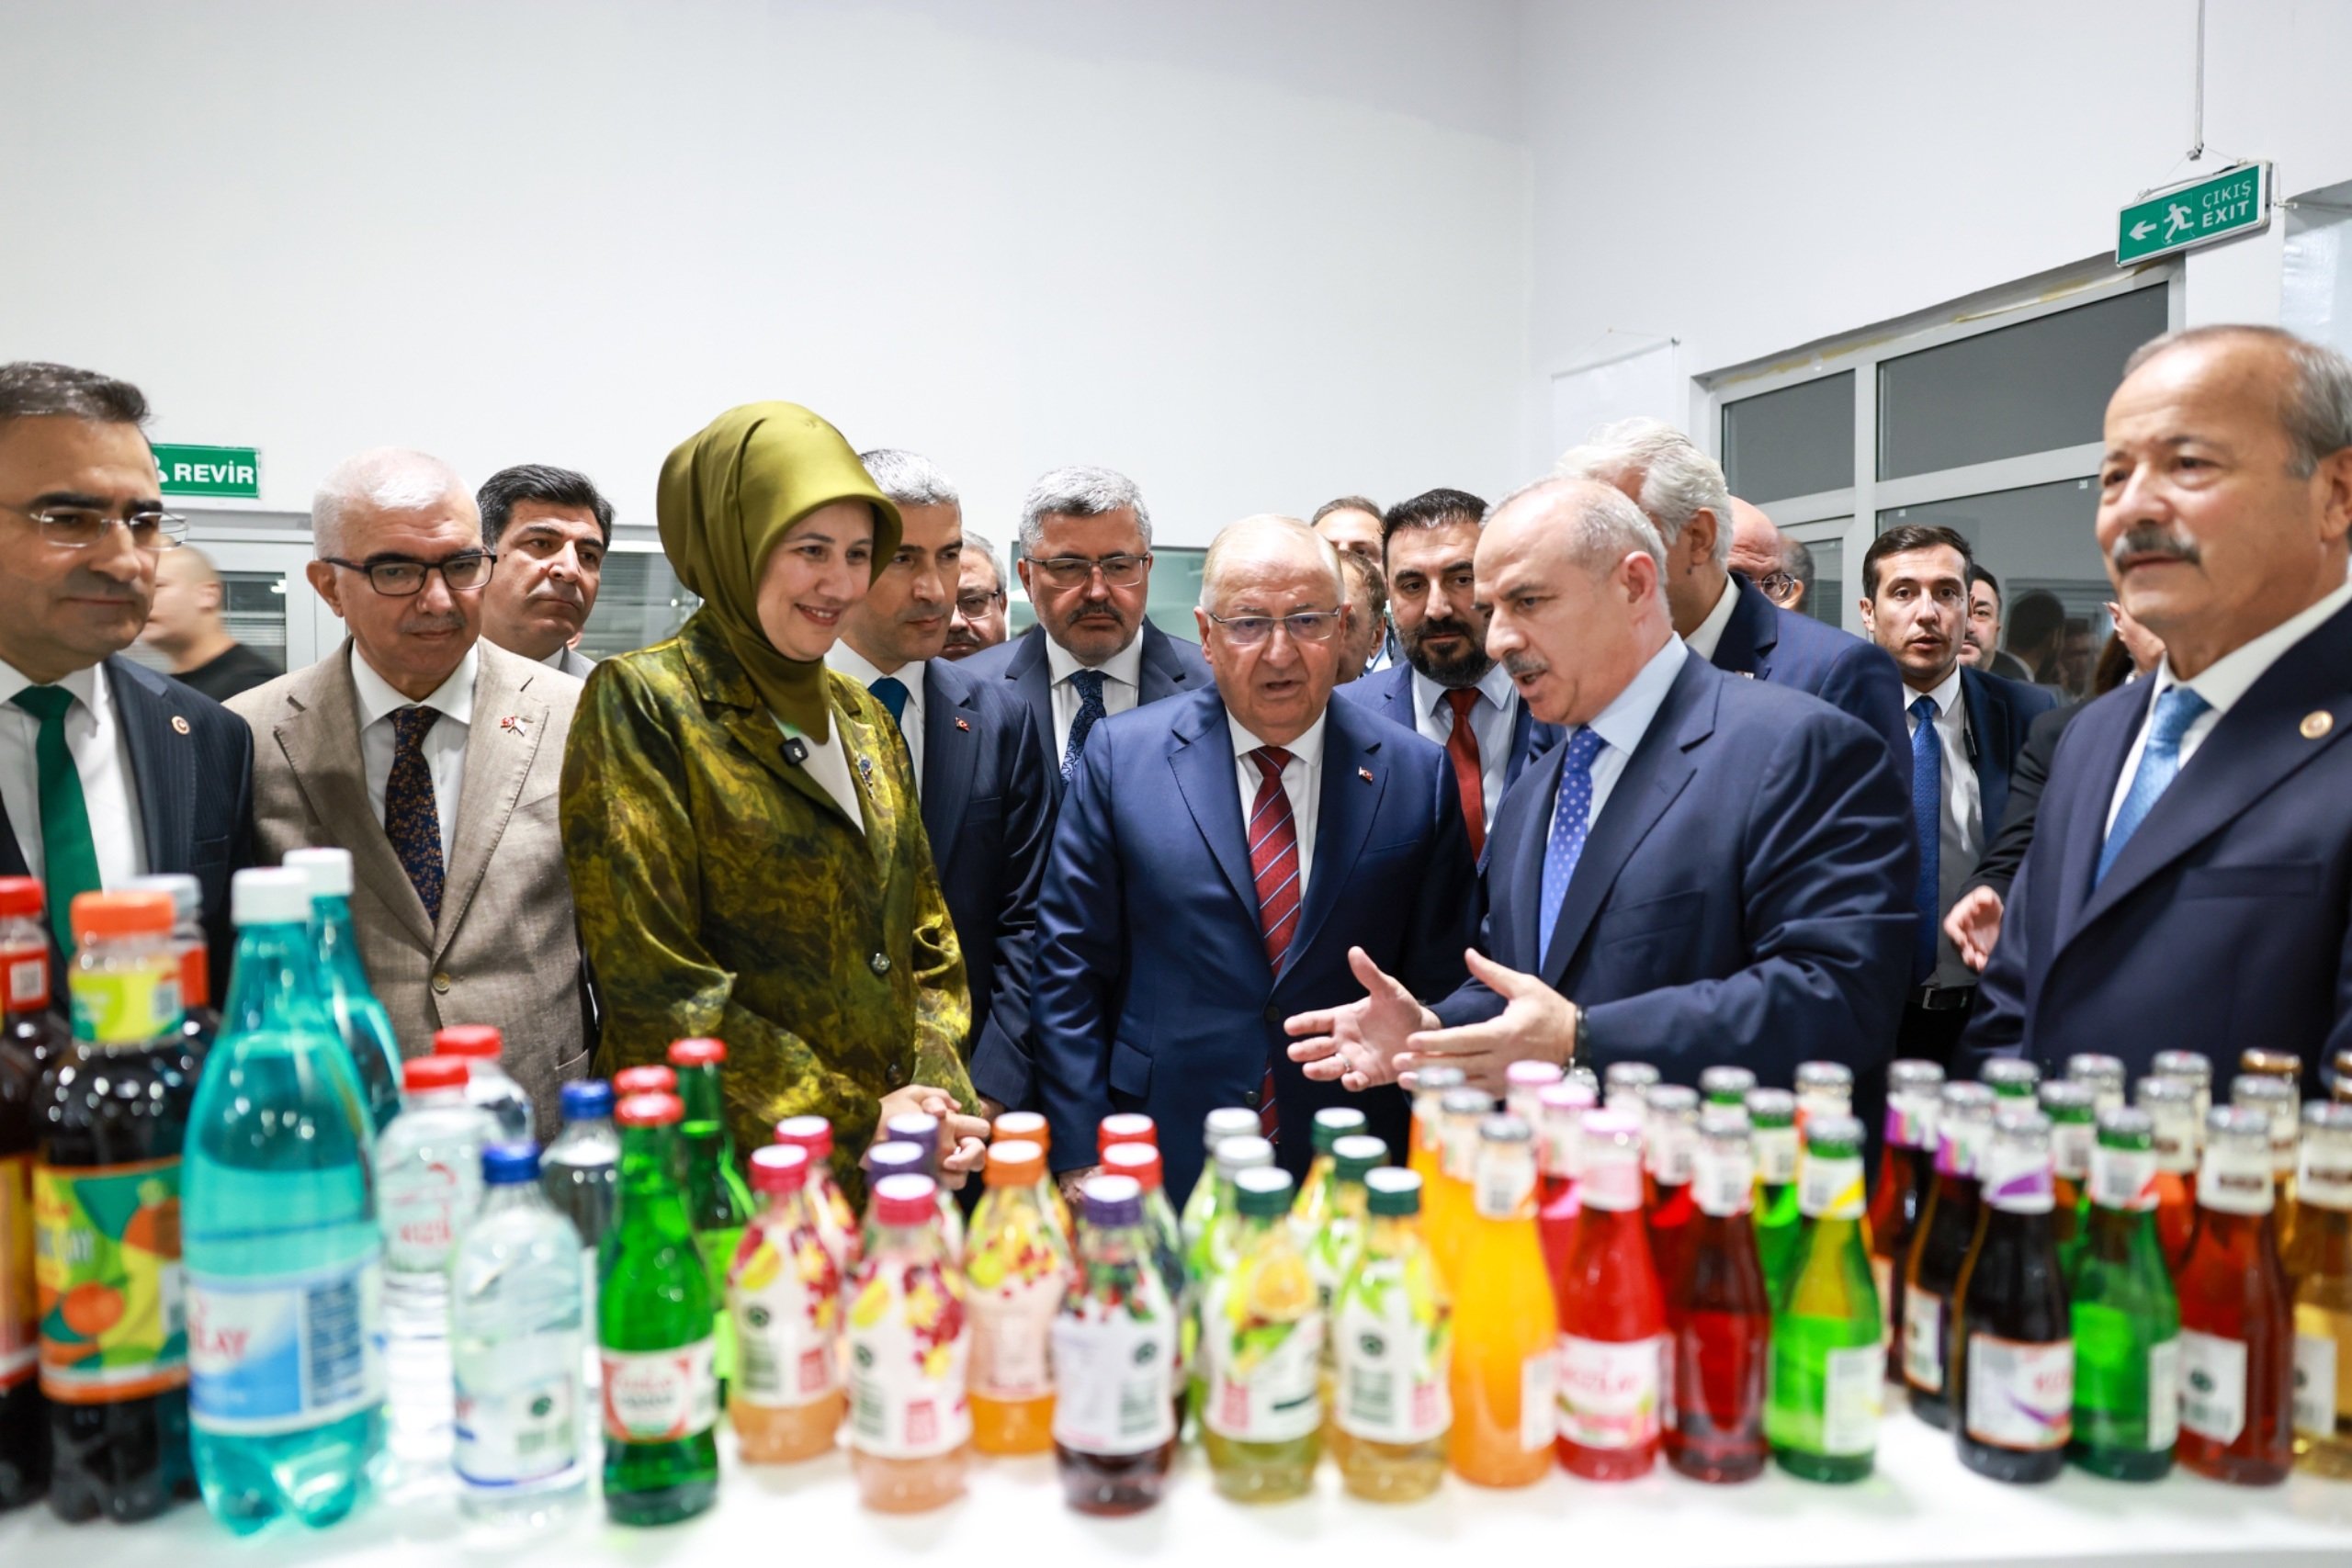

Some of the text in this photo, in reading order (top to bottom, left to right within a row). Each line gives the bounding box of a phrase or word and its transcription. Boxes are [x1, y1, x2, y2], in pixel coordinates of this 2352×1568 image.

[2202, 179, 2252, 210] ÇIKIŞ
[2202, 199, 2250, 228] EXIT
[174, 459, 254, 485] REVİR
